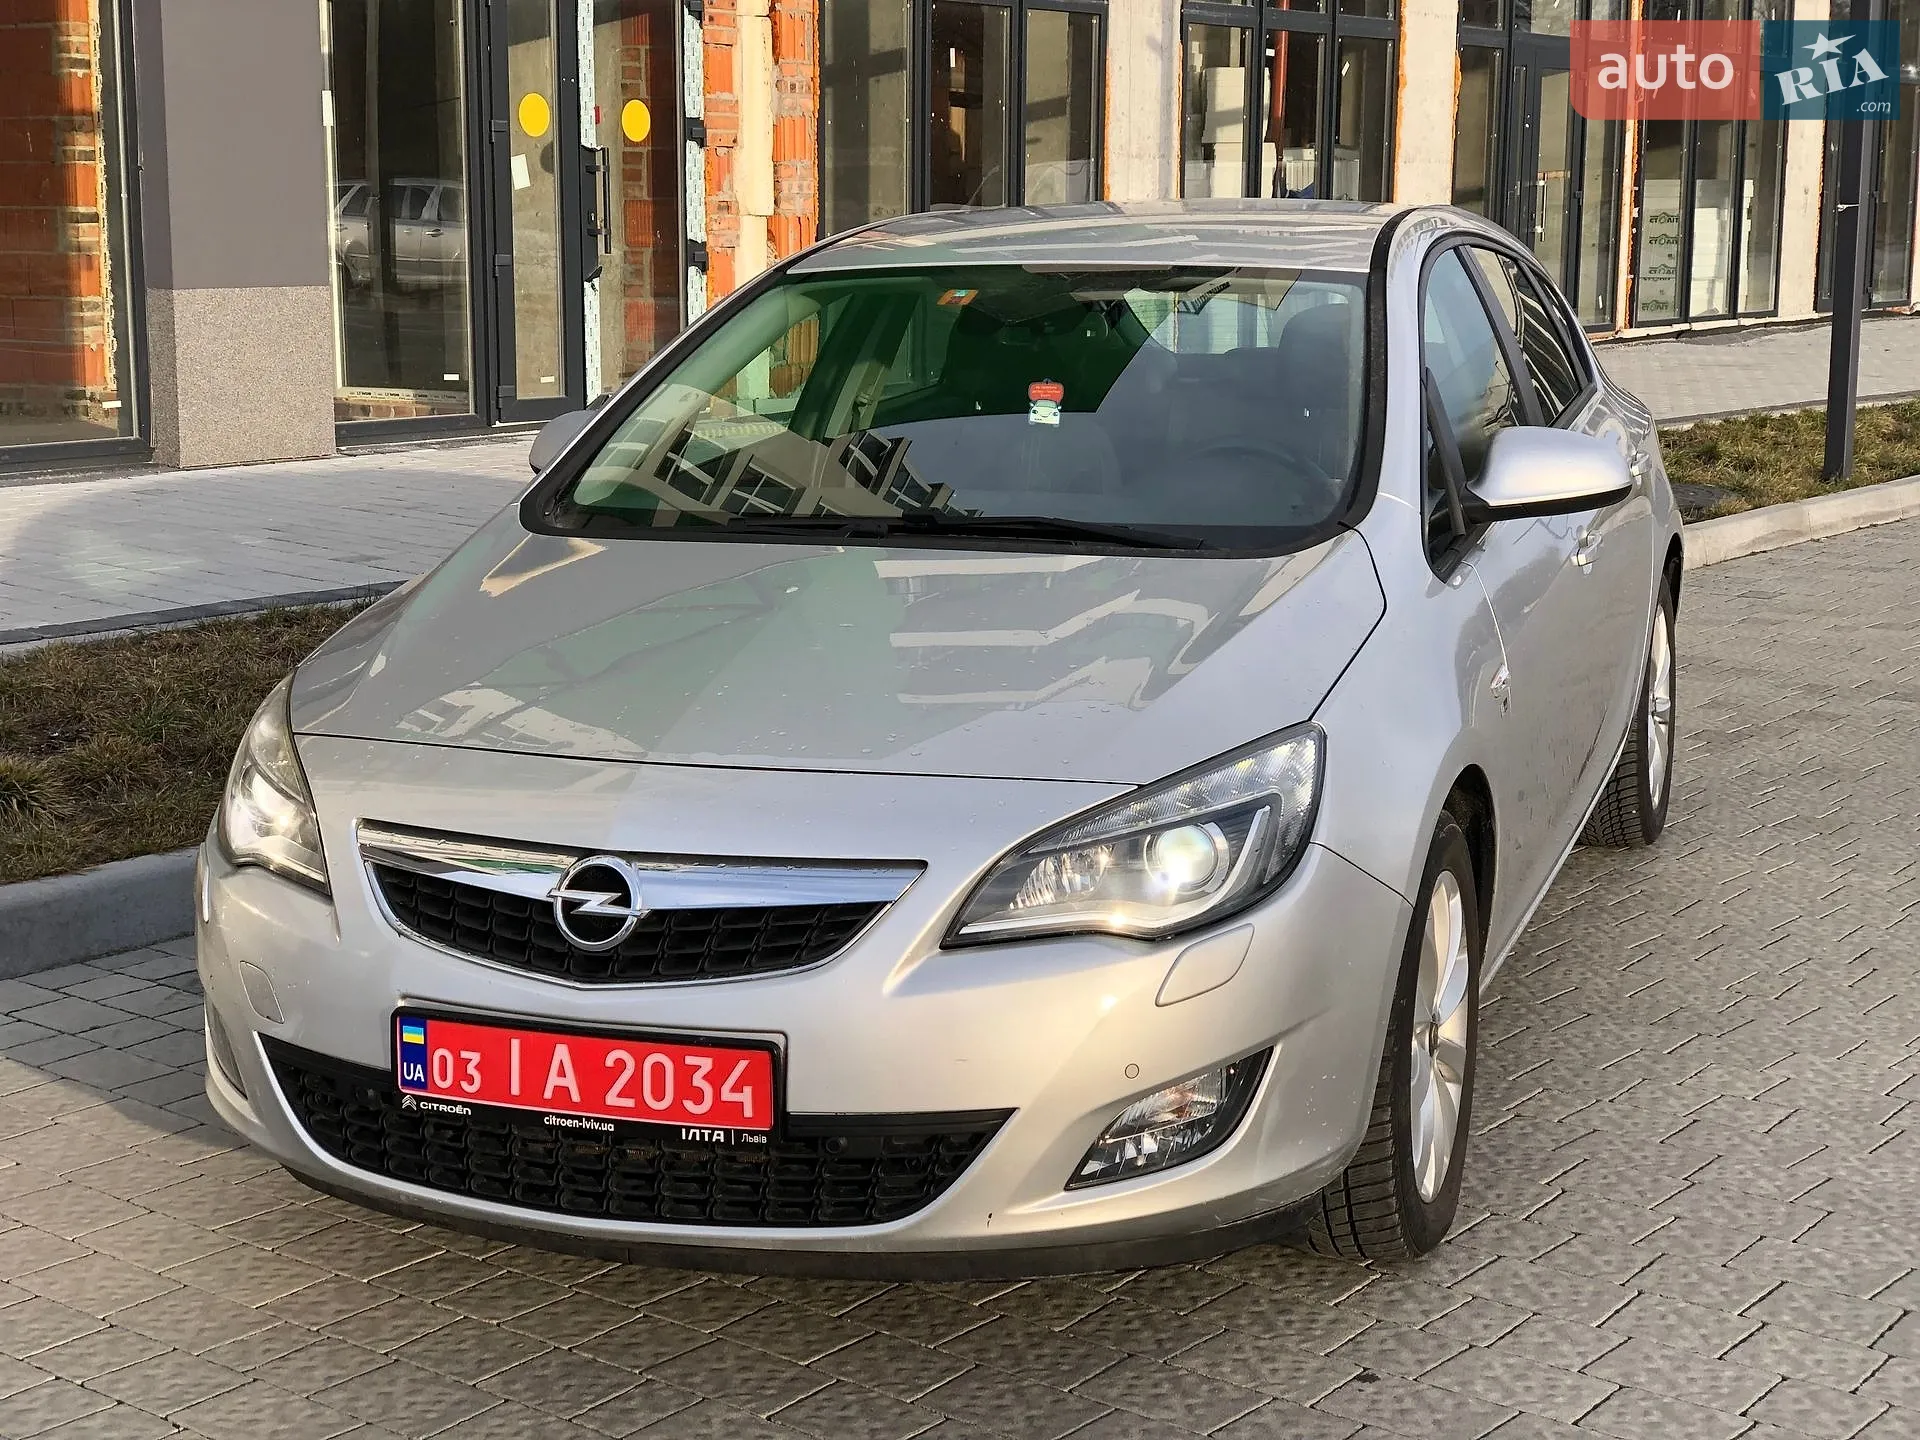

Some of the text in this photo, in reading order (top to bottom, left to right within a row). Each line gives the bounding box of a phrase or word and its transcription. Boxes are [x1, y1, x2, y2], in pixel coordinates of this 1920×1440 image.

[403, 1063, 425, 1083] UA
[432, 1047, 482, 1094] 03
[604, 1049, 754, 1119] 2034
[543, 1114, 615, 1132] citroen-lviv.ua
[681, 1128, 768, 1144] ІЛТА Львів
